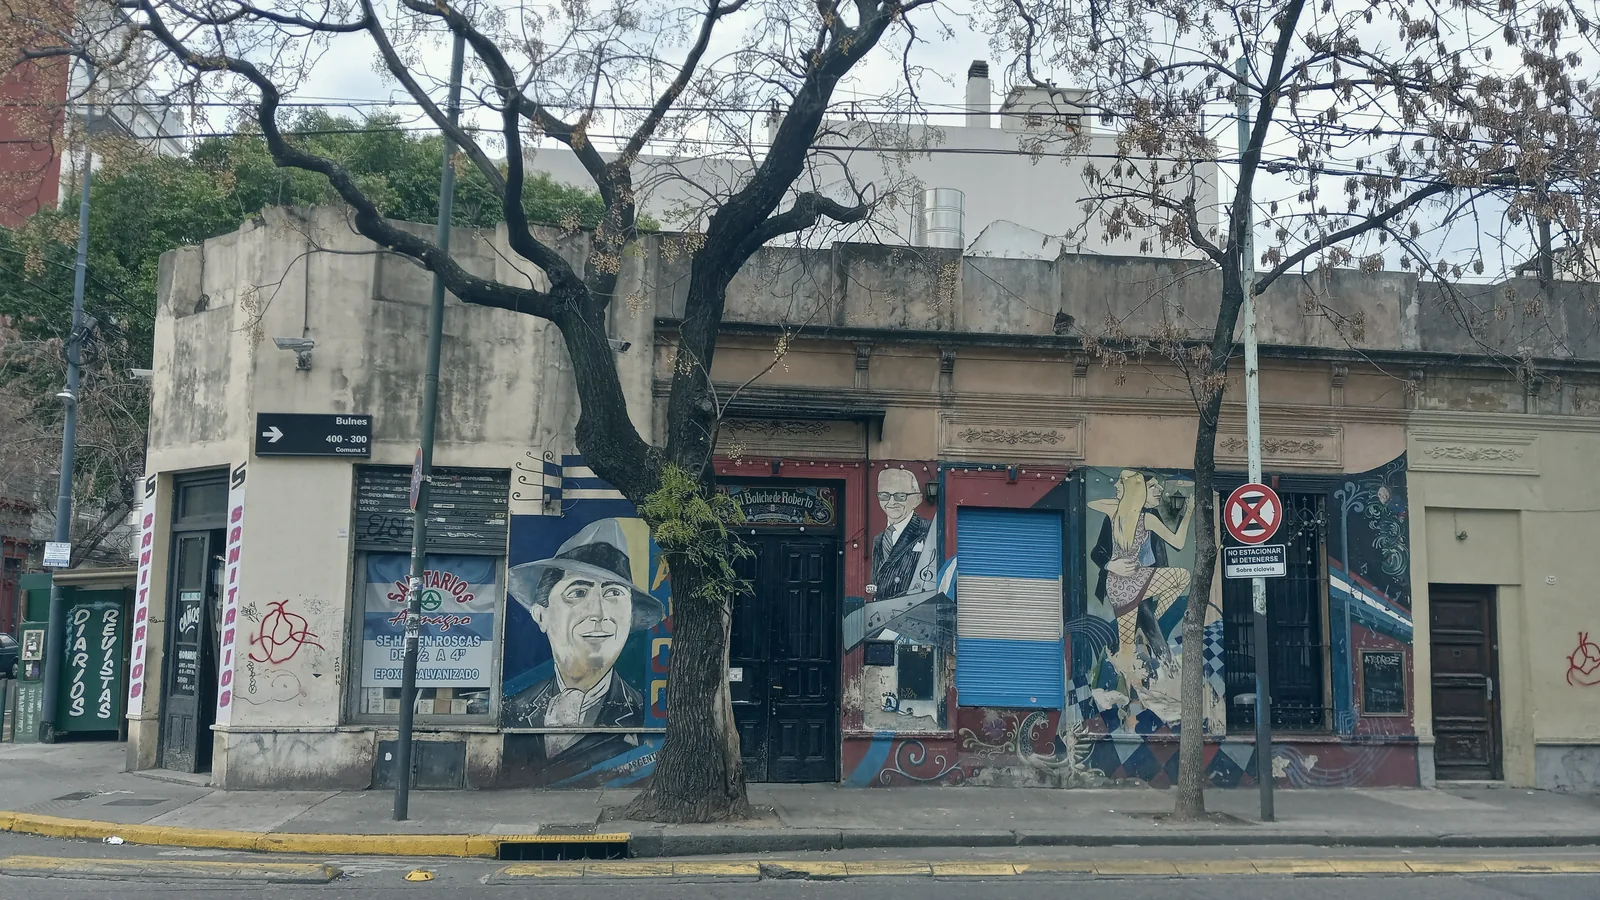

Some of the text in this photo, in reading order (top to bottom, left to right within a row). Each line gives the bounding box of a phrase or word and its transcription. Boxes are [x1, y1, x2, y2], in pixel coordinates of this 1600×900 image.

[336, 417, 368, 426] Bulnes
[326, 435, 343, 443] 400
[350, 435, 368, 444] 300
[782, 491, 814, 509] Roberto
[1228, 547, 1281, 557] NO ESTACIONAR
[1240, 555, 1278, 563] DETENERSE
[387, 570, 475, 604] SATARIOS
[130, 512, 154, 699] SANITARIOS
[218, 505, 243, 708] SANITARIOS
[376, 635, 481, 647] SE HAEN ROSCAS
[435, 648, 446, 661] A
[69, 609, 91, 717] DIARIOS
[97, 609, 120, 719] REVISTAS
